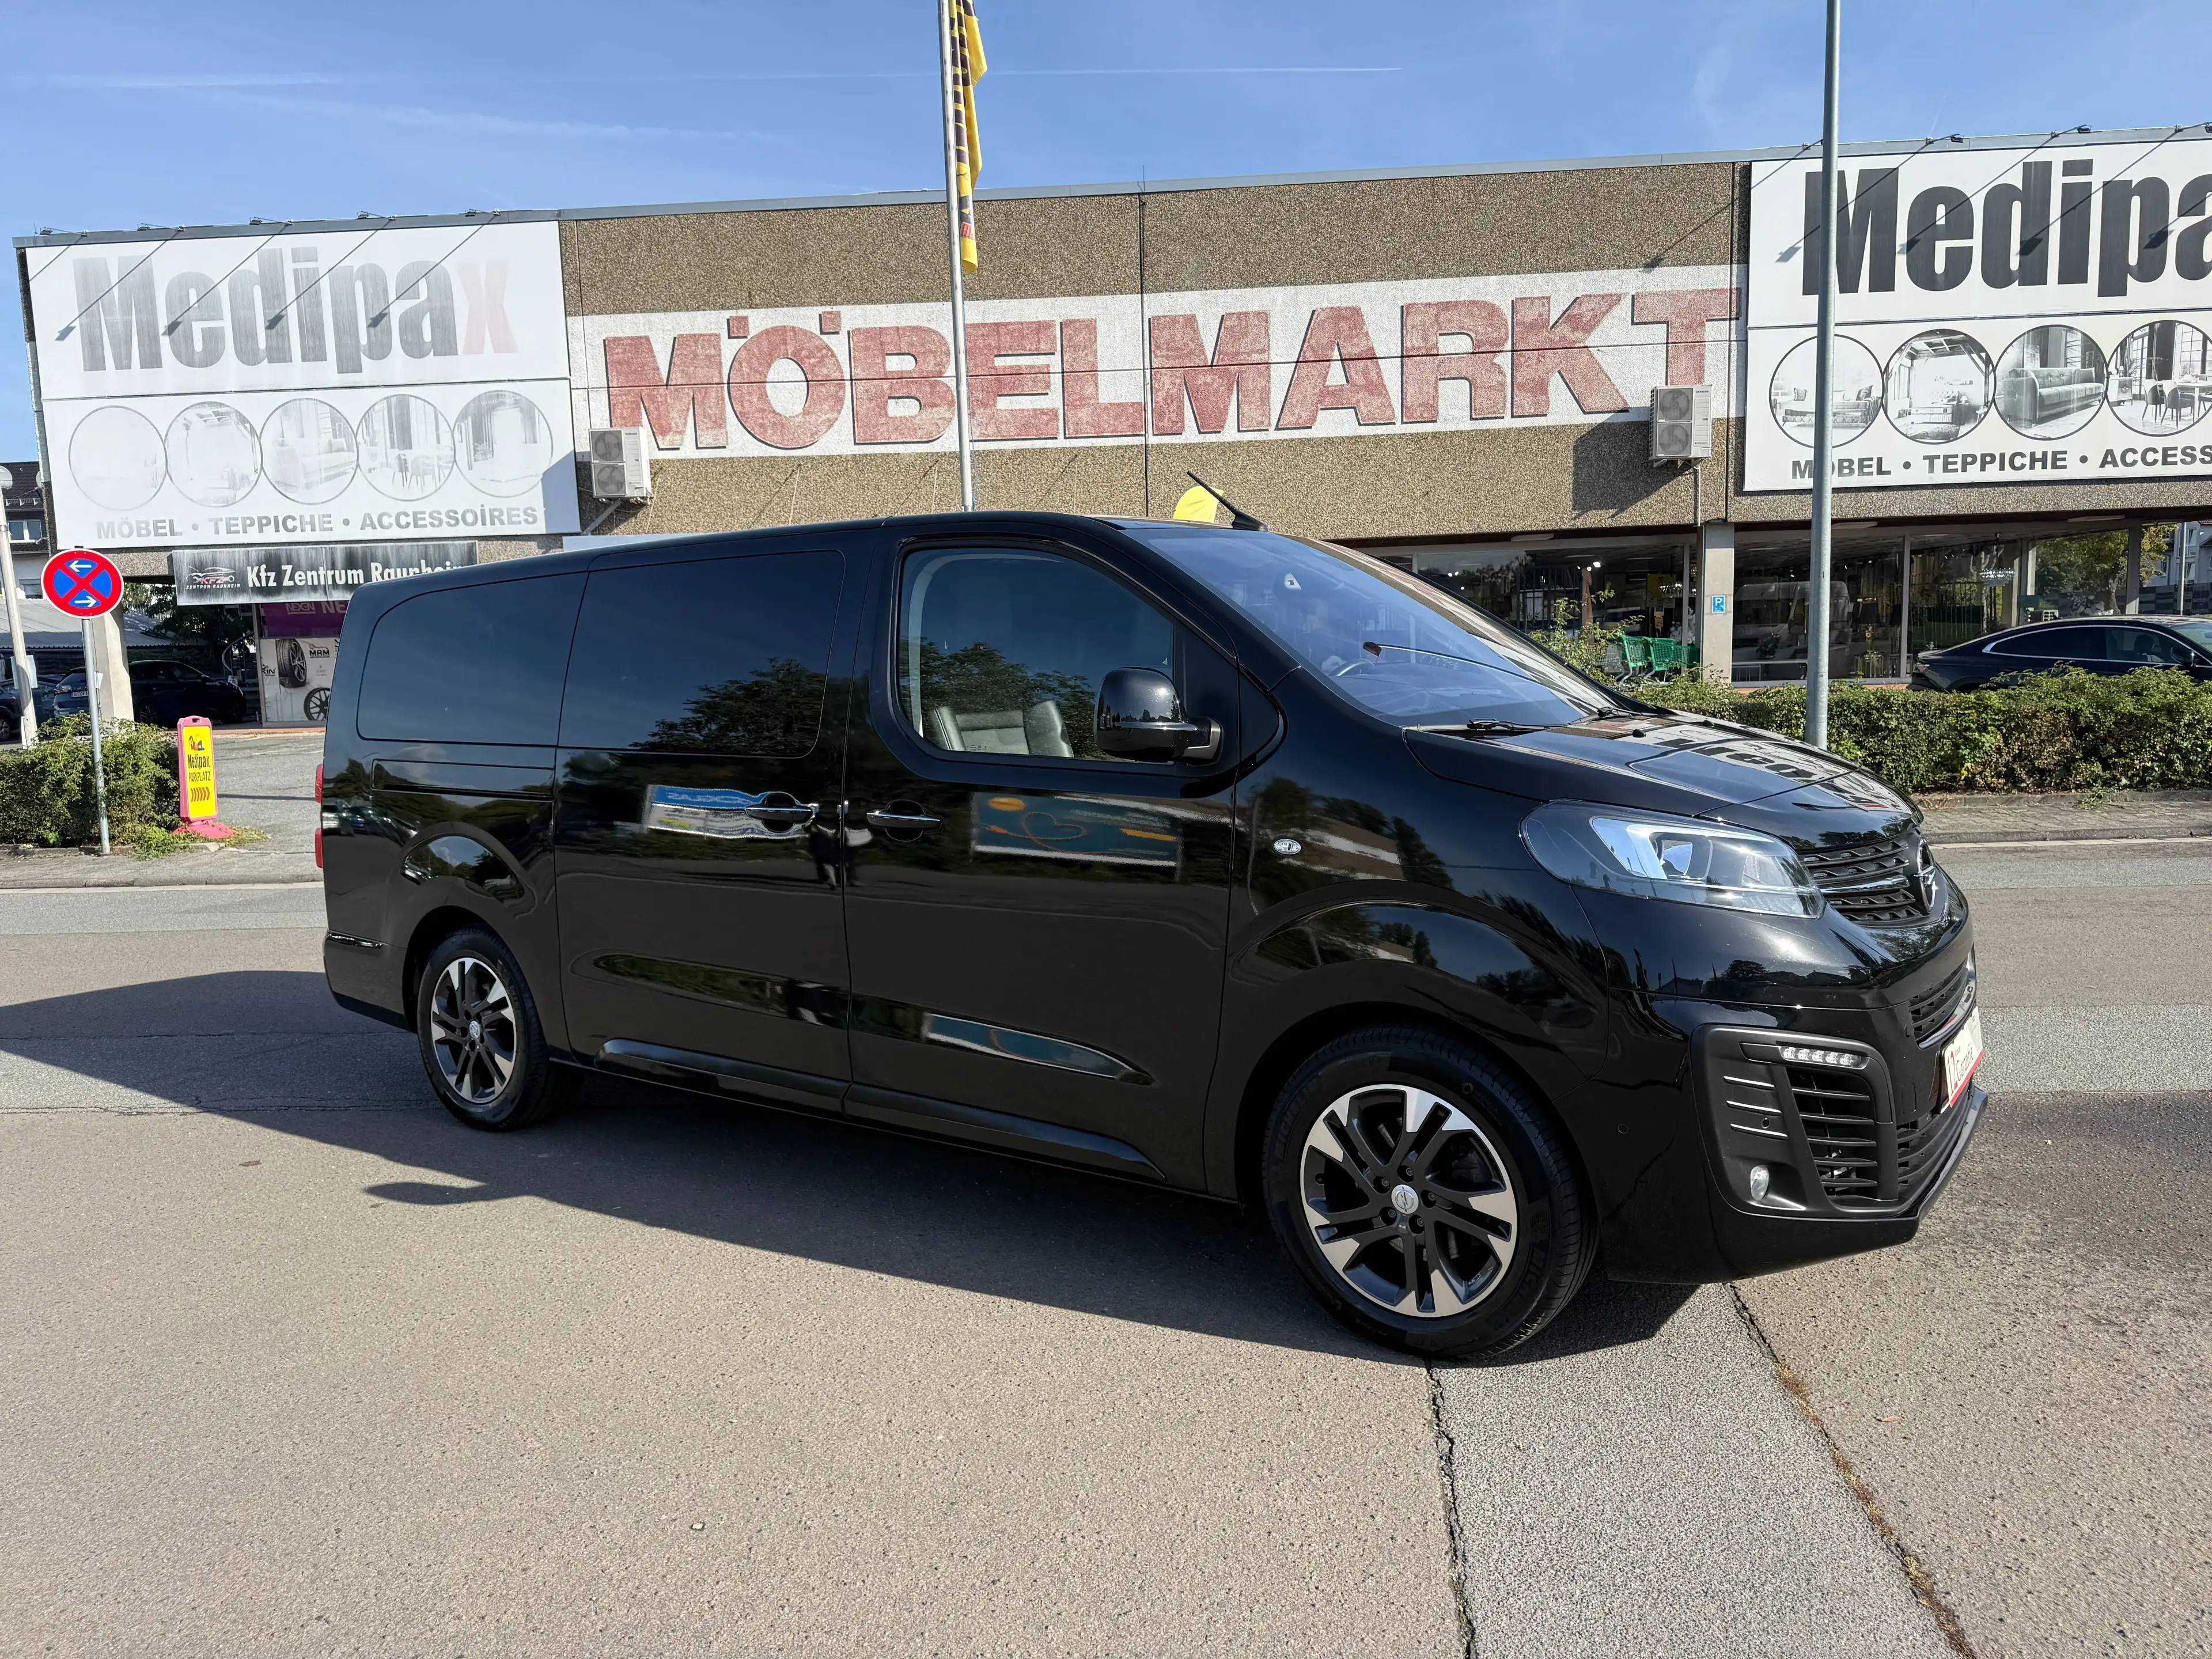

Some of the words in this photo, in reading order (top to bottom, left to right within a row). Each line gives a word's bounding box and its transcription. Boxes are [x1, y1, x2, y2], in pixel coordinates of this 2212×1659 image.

[72, 247, 519, 374] Medipax
[603, 287, 1741, 450] MÖBELMARKT
[1792, 457, 1891, 479] MBEL
[1923, 450, 2067, 474] TEPPICHE
[2099, 445, 2212, 468] ACCESS
[96, 517, 183, 539] MÖBEL
[208, 514, 333, 534] TEPPICHE
[247, 565, 276, 588] Kfz
[281, 565, 364, 586] Zentrum
[370, 559, 463, 582] Raunh
[187, 753, 210, 770] Medipax
[189, 771, 211, 782] PARKPLATZ
[1956, 1043, 1974, 1081] Garantie
